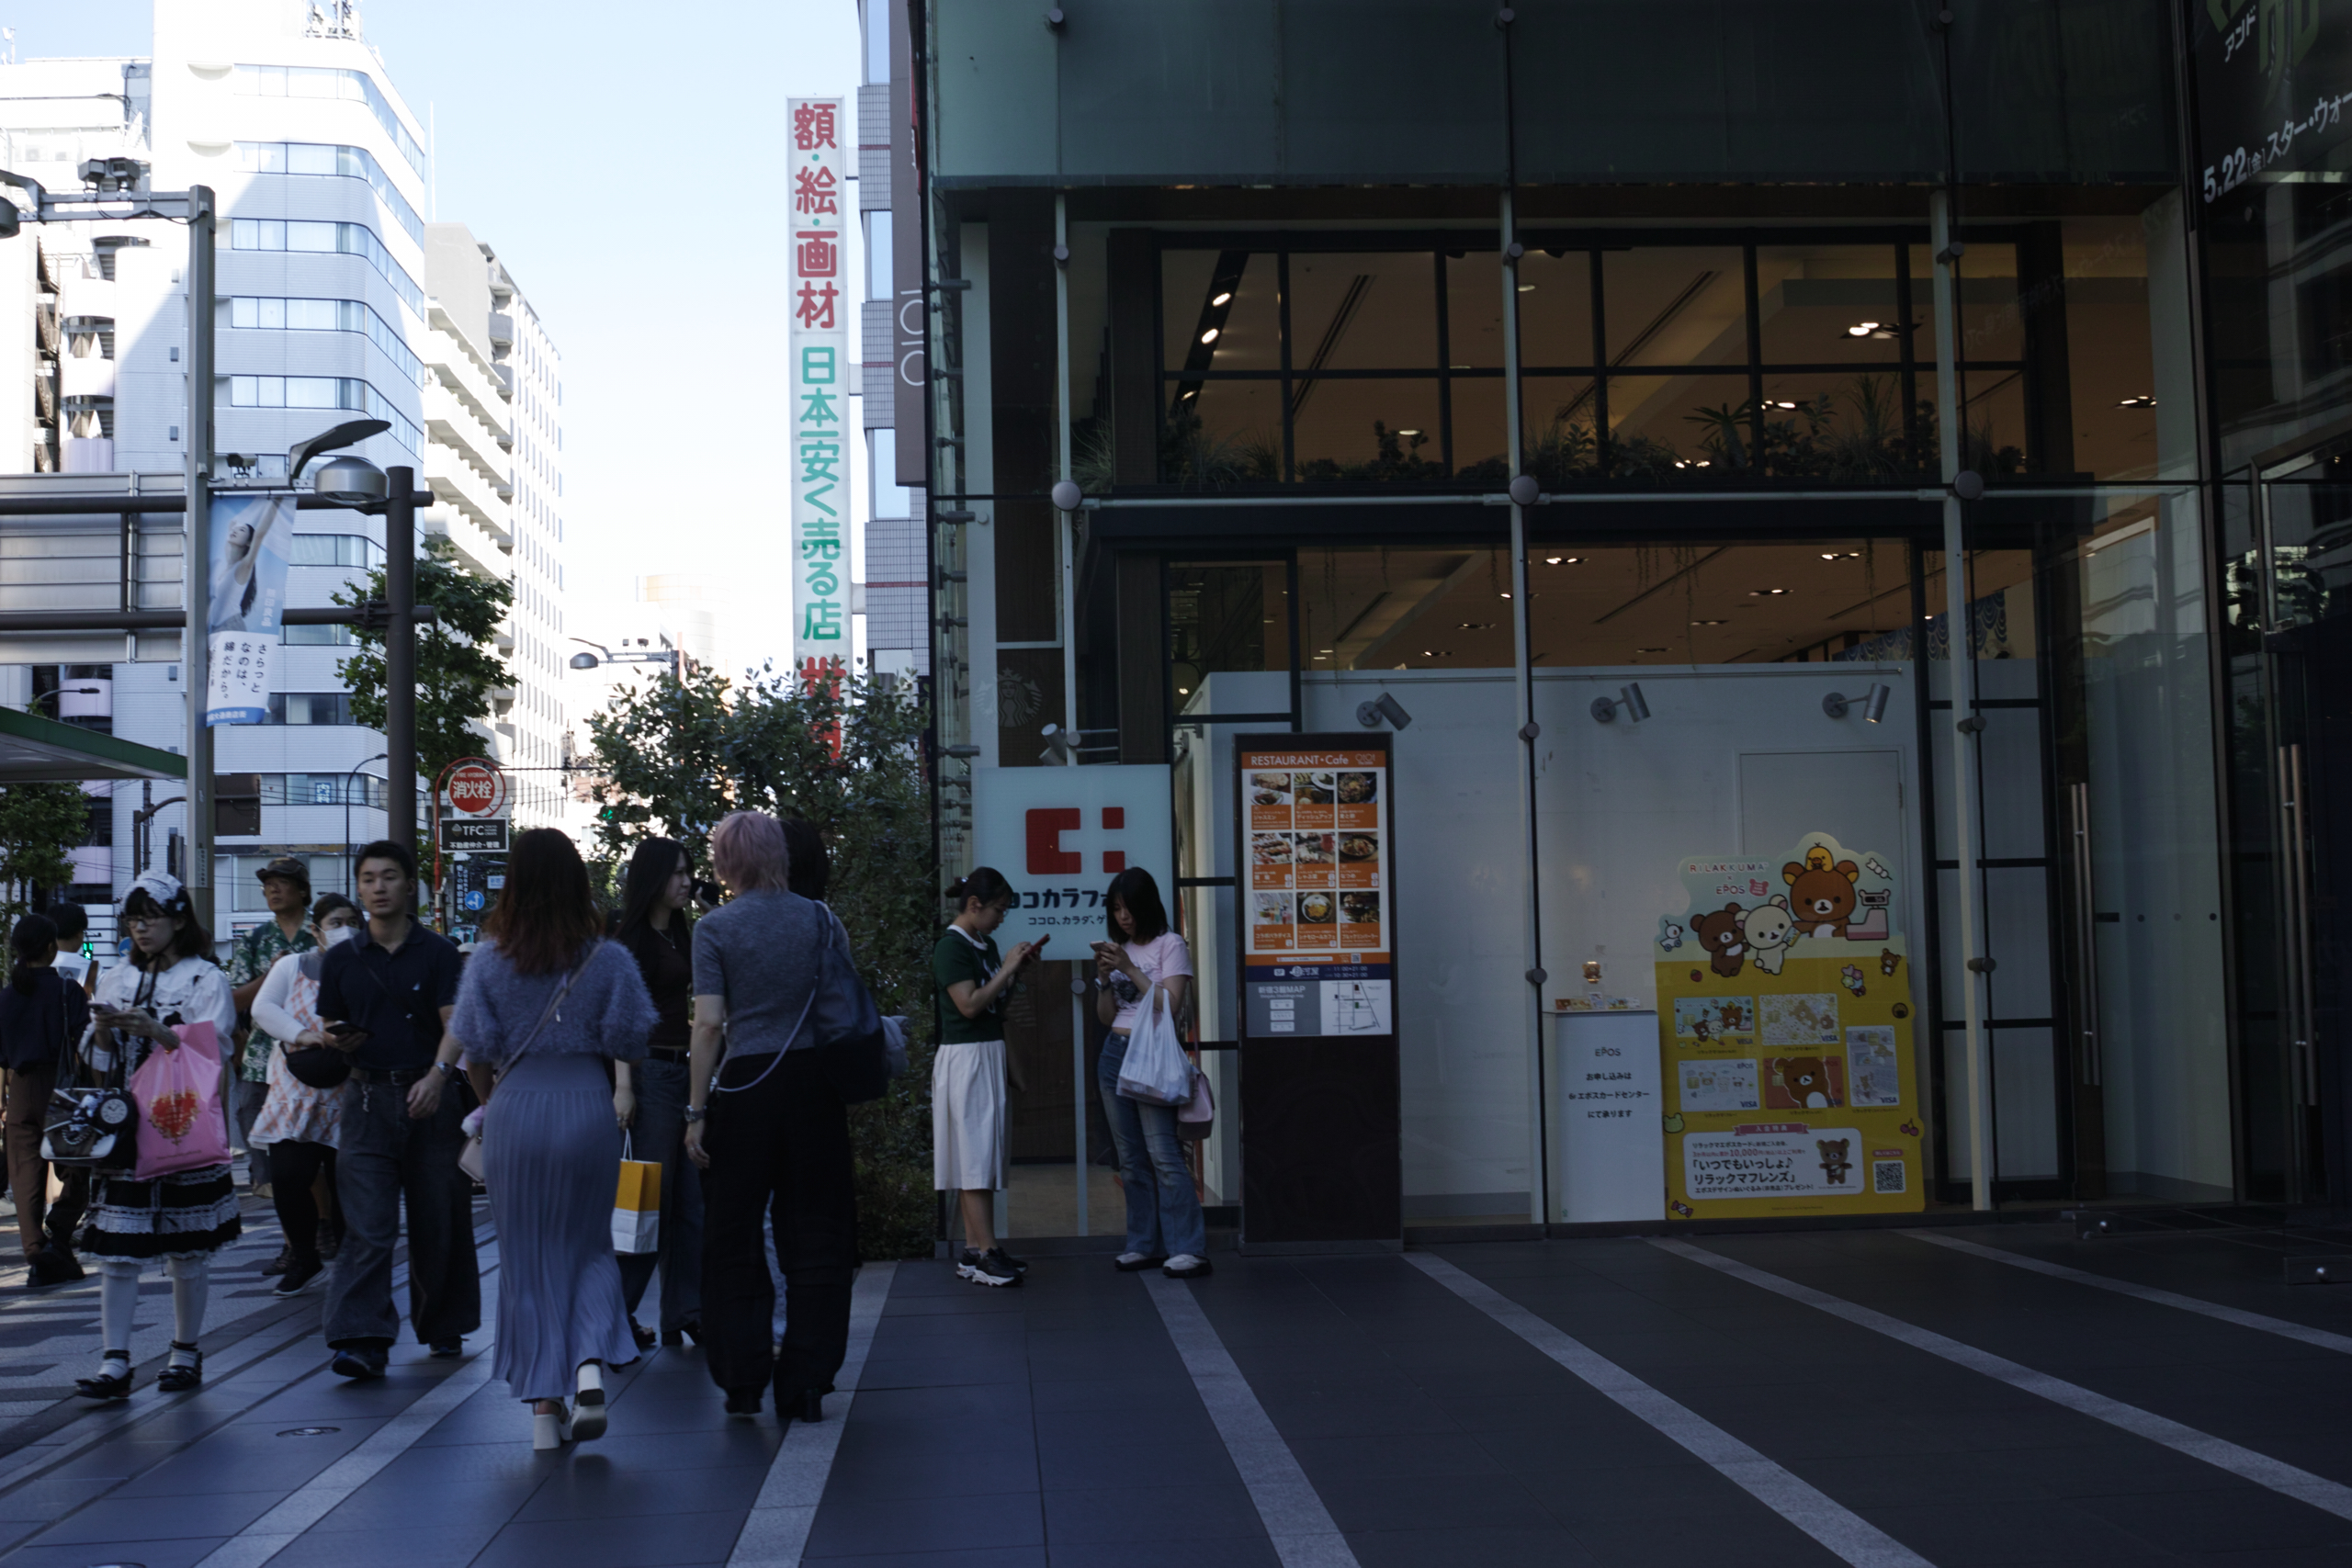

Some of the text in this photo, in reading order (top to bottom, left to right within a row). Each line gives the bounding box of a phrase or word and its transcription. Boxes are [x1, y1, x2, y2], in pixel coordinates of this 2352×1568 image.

[799, 345, 842, 641] 日本一安く売る店
[316, 783, 331, 804] 内科
[453, 781, 492, 798] 消火栓
[462, 825, 484, 836] TFC
[1595, 1047, 1622, 1057] EPOS
[1586, 1072, 1632, 1081] お申し込みは
[1588, 1110, 1633, 1119] にて承ります
